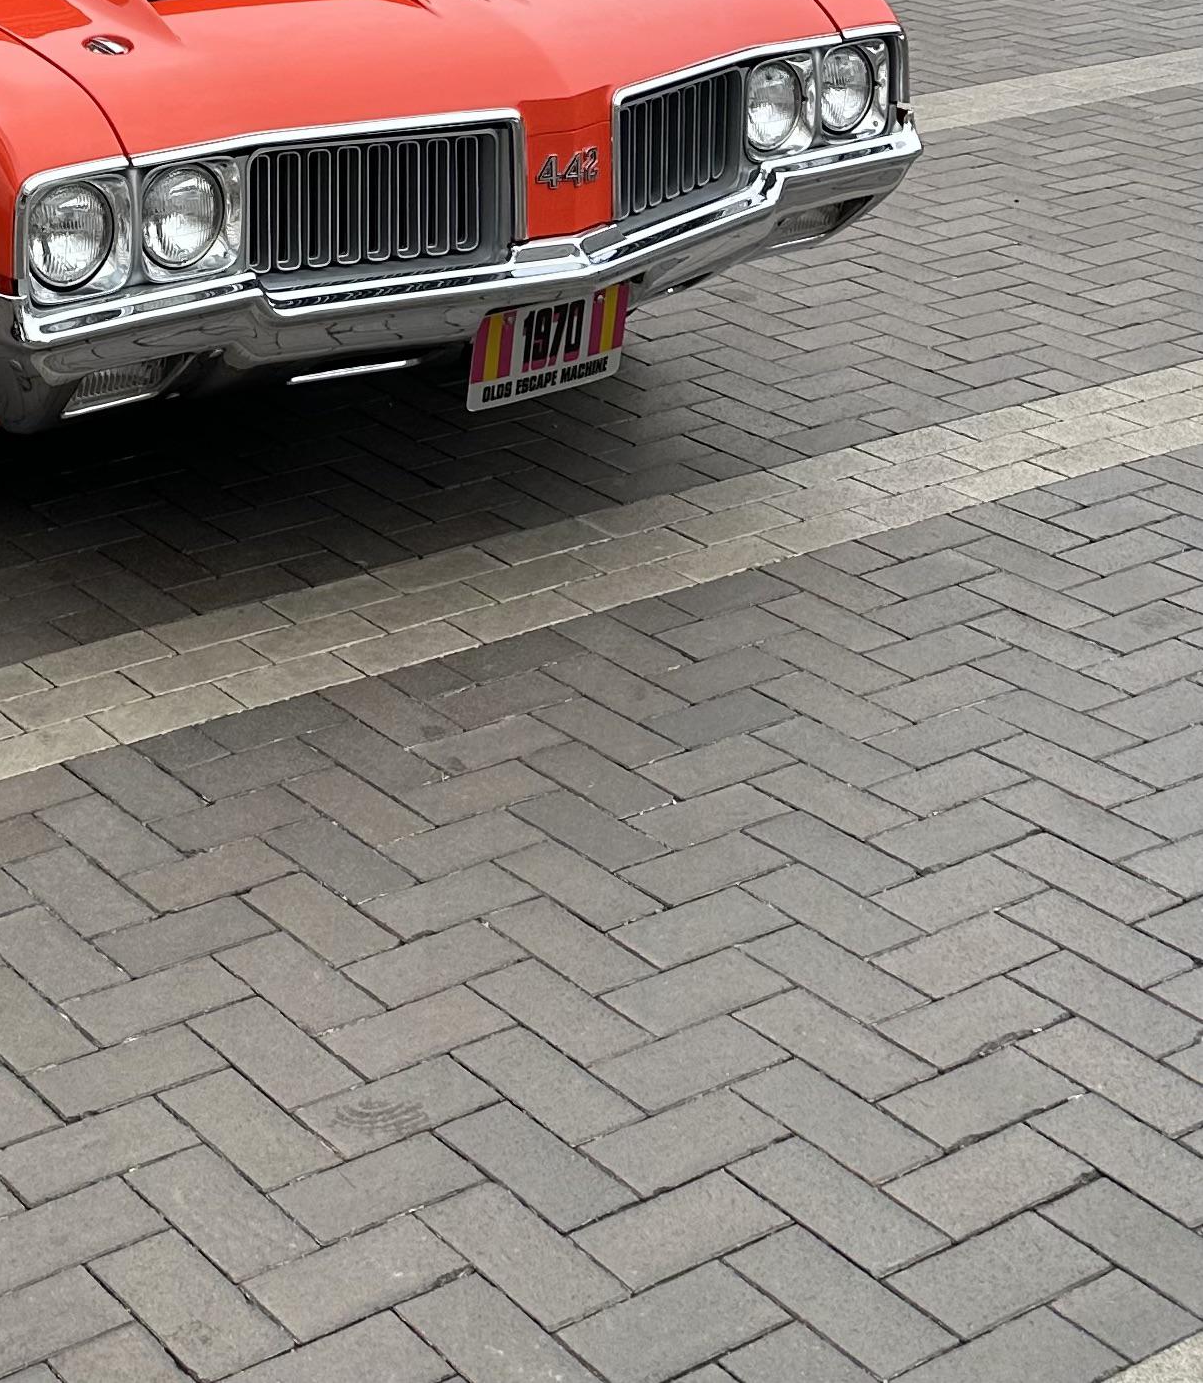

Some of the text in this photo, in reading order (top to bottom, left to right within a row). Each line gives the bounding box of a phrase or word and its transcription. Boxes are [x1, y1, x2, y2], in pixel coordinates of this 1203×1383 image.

[536, 146, 599, 190] 442
[522, 299, 586, 373] 1970
[482, 356, 609, 403] OLDS ESCAPE MACHINE
